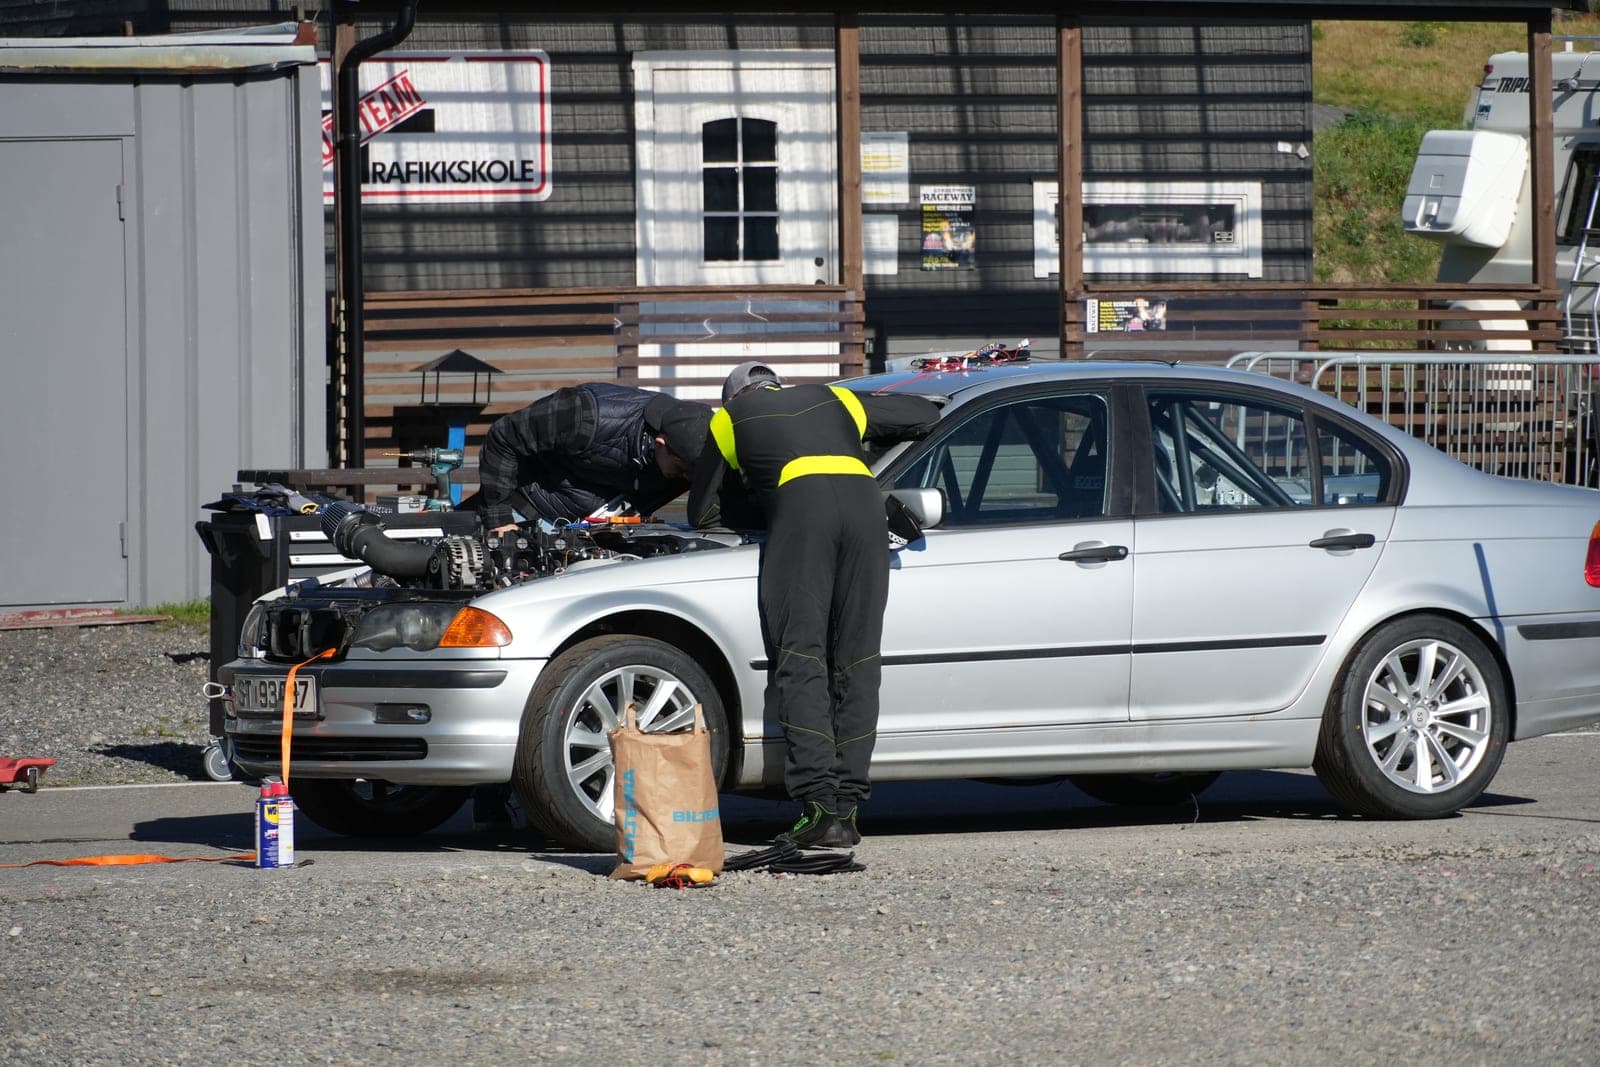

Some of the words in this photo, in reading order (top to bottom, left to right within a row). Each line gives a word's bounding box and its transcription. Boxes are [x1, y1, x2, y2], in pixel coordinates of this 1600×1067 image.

[1496, 77, 1529, 93] TRIPL
[359, 76, 422, 134] TEAM
[372, 160, 534, 184] RAFIKKSKOLE
